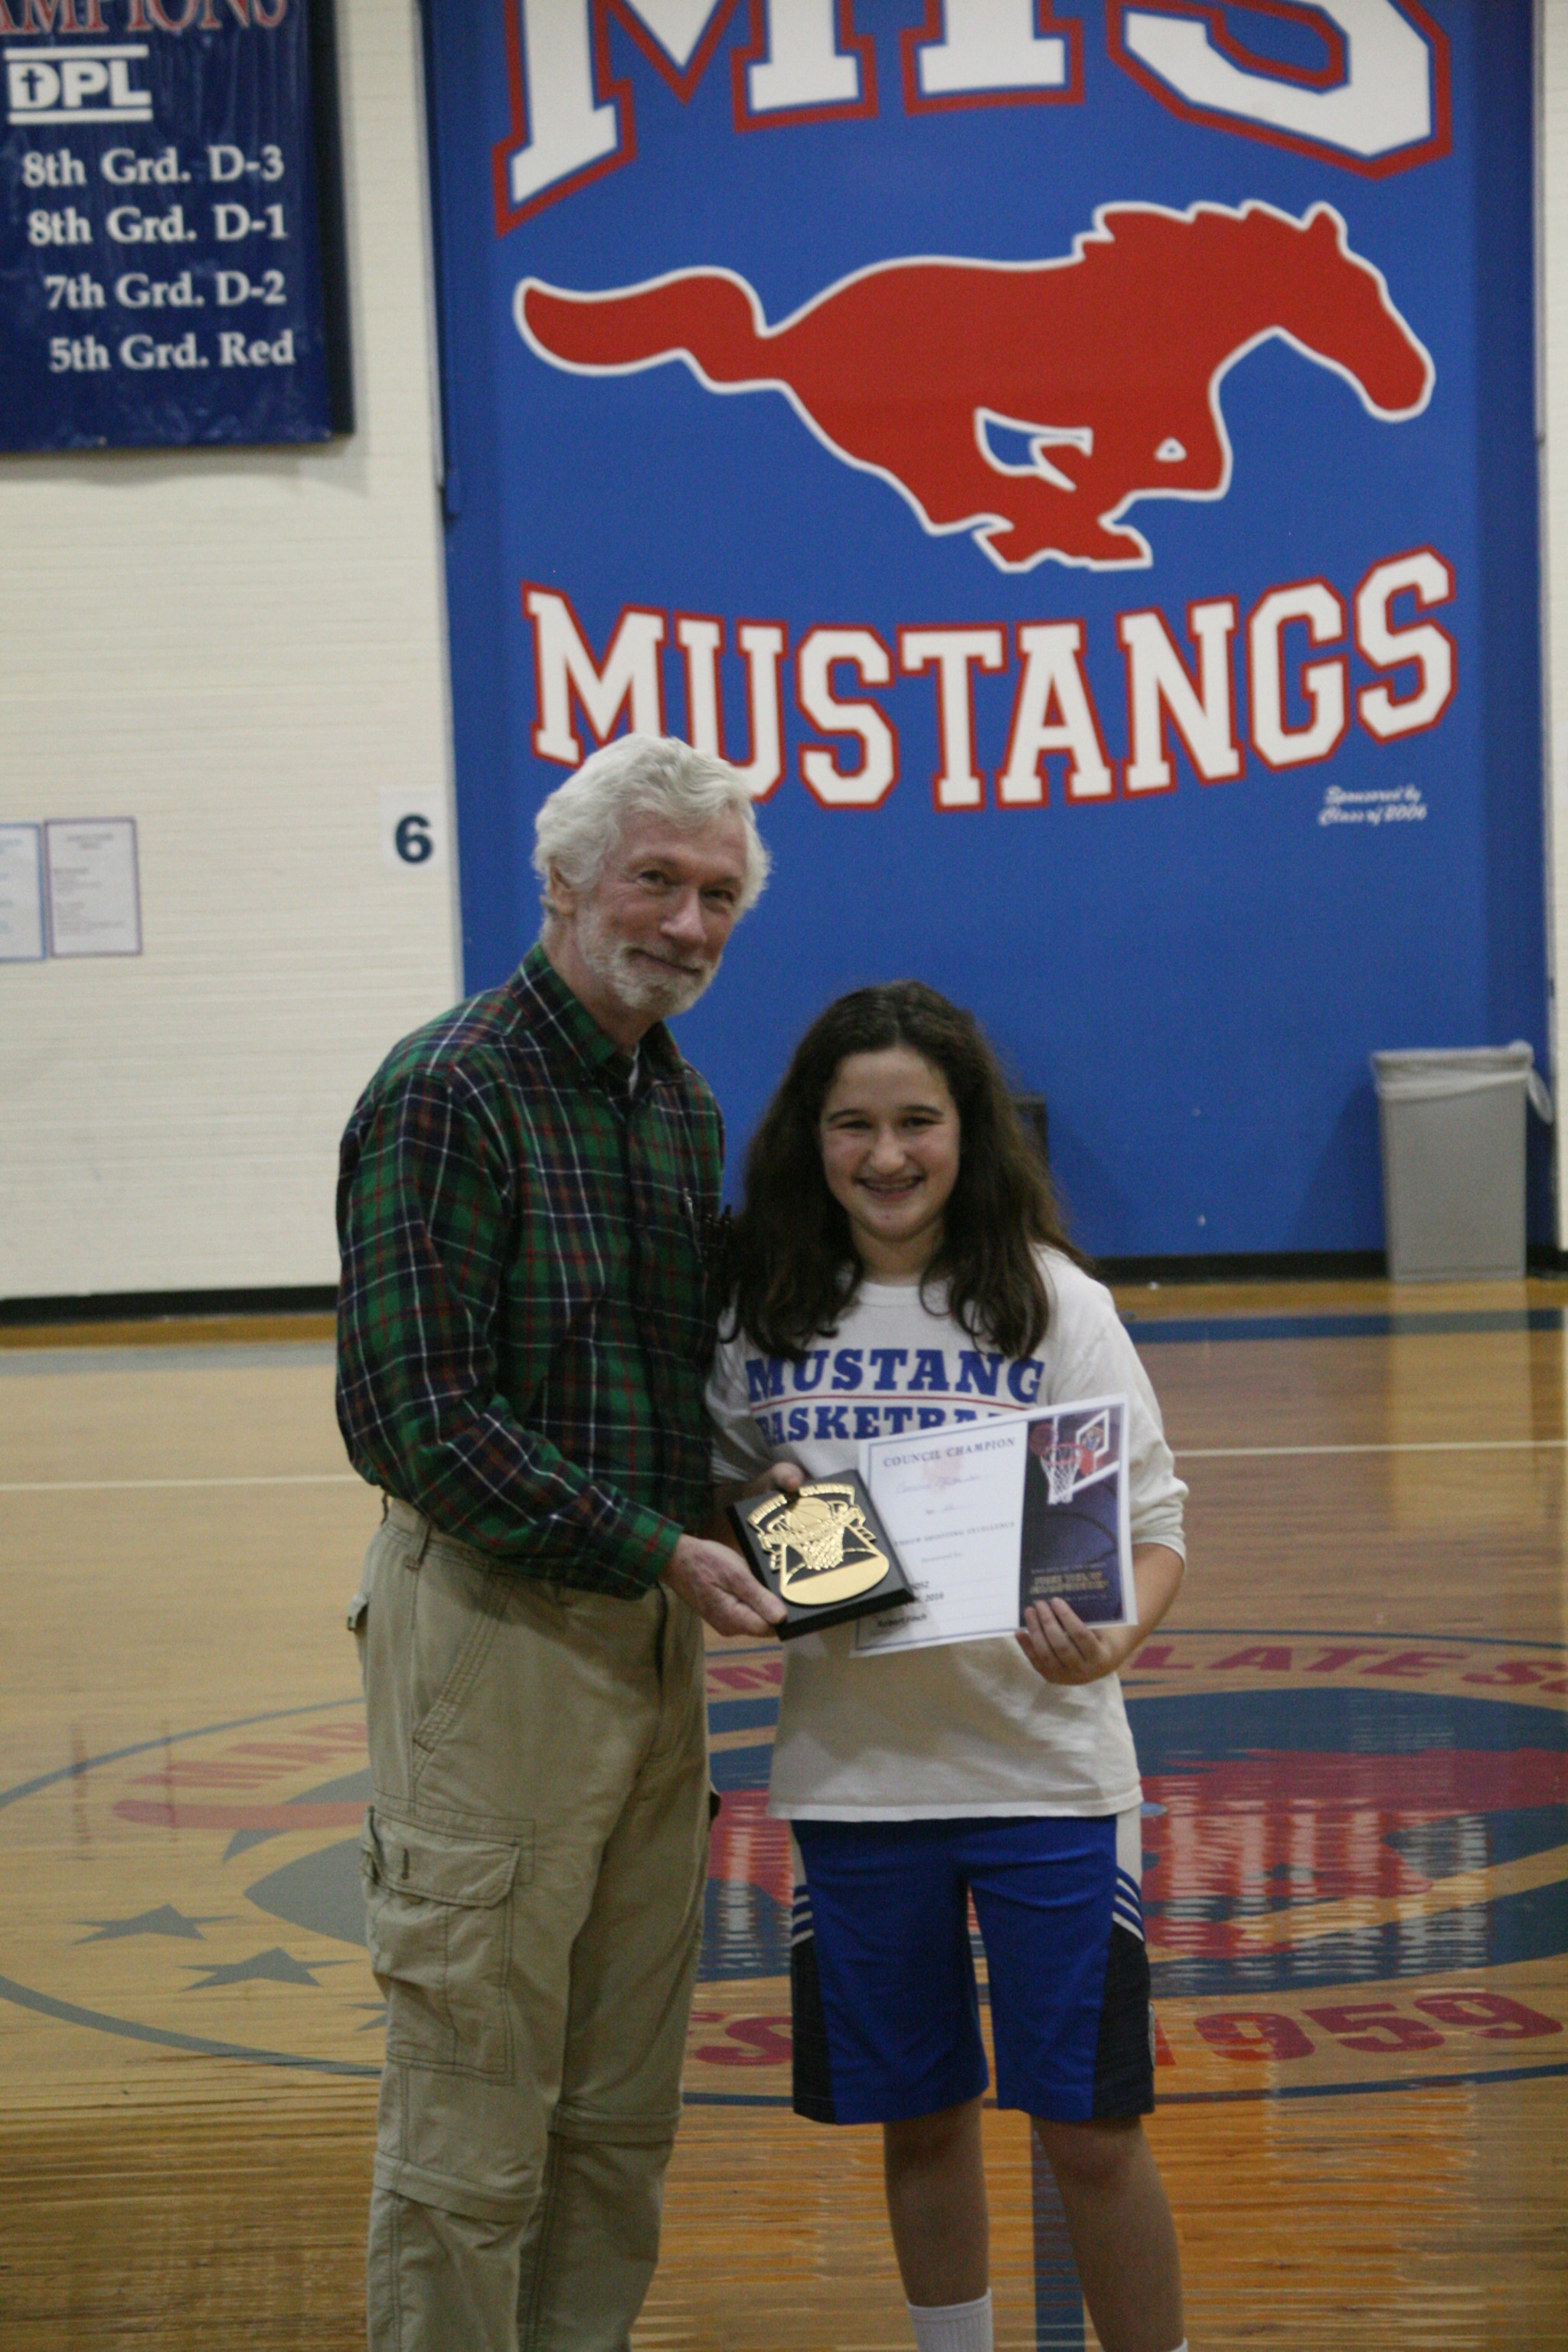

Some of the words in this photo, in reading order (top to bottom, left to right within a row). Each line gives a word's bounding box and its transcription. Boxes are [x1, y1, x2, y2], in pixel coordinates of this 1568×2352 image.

[8, 60, 152, 109] DPL
[22, 149, 87, 187] 8th
[100, 147, 191, 186] Grd.
[208, 145, 285, 182] D-3
[28, 207, 93, 247] 8th
[107, 205, 197, 244] Grd.
[214, 204, 288, 241] D-1
[44, 273, 106, 309] 7th
[116, 272, 205, 308] Grd.
[216, 270, 287, 306] D-2
[49, 335, 110, 373] 5th
[119, 333, 209, 370] Grd.
[219, 329, 296, 368] Red
[521, 547, 1457, 810] MUSTANGS
[394, 814, 435, 864] 6
[746, 1348, 1045, 1404] MUSTANG
[883, 1450, 942, 1468] COUNCIL
[946, 1436, 1017, 1459] CHAMPION
